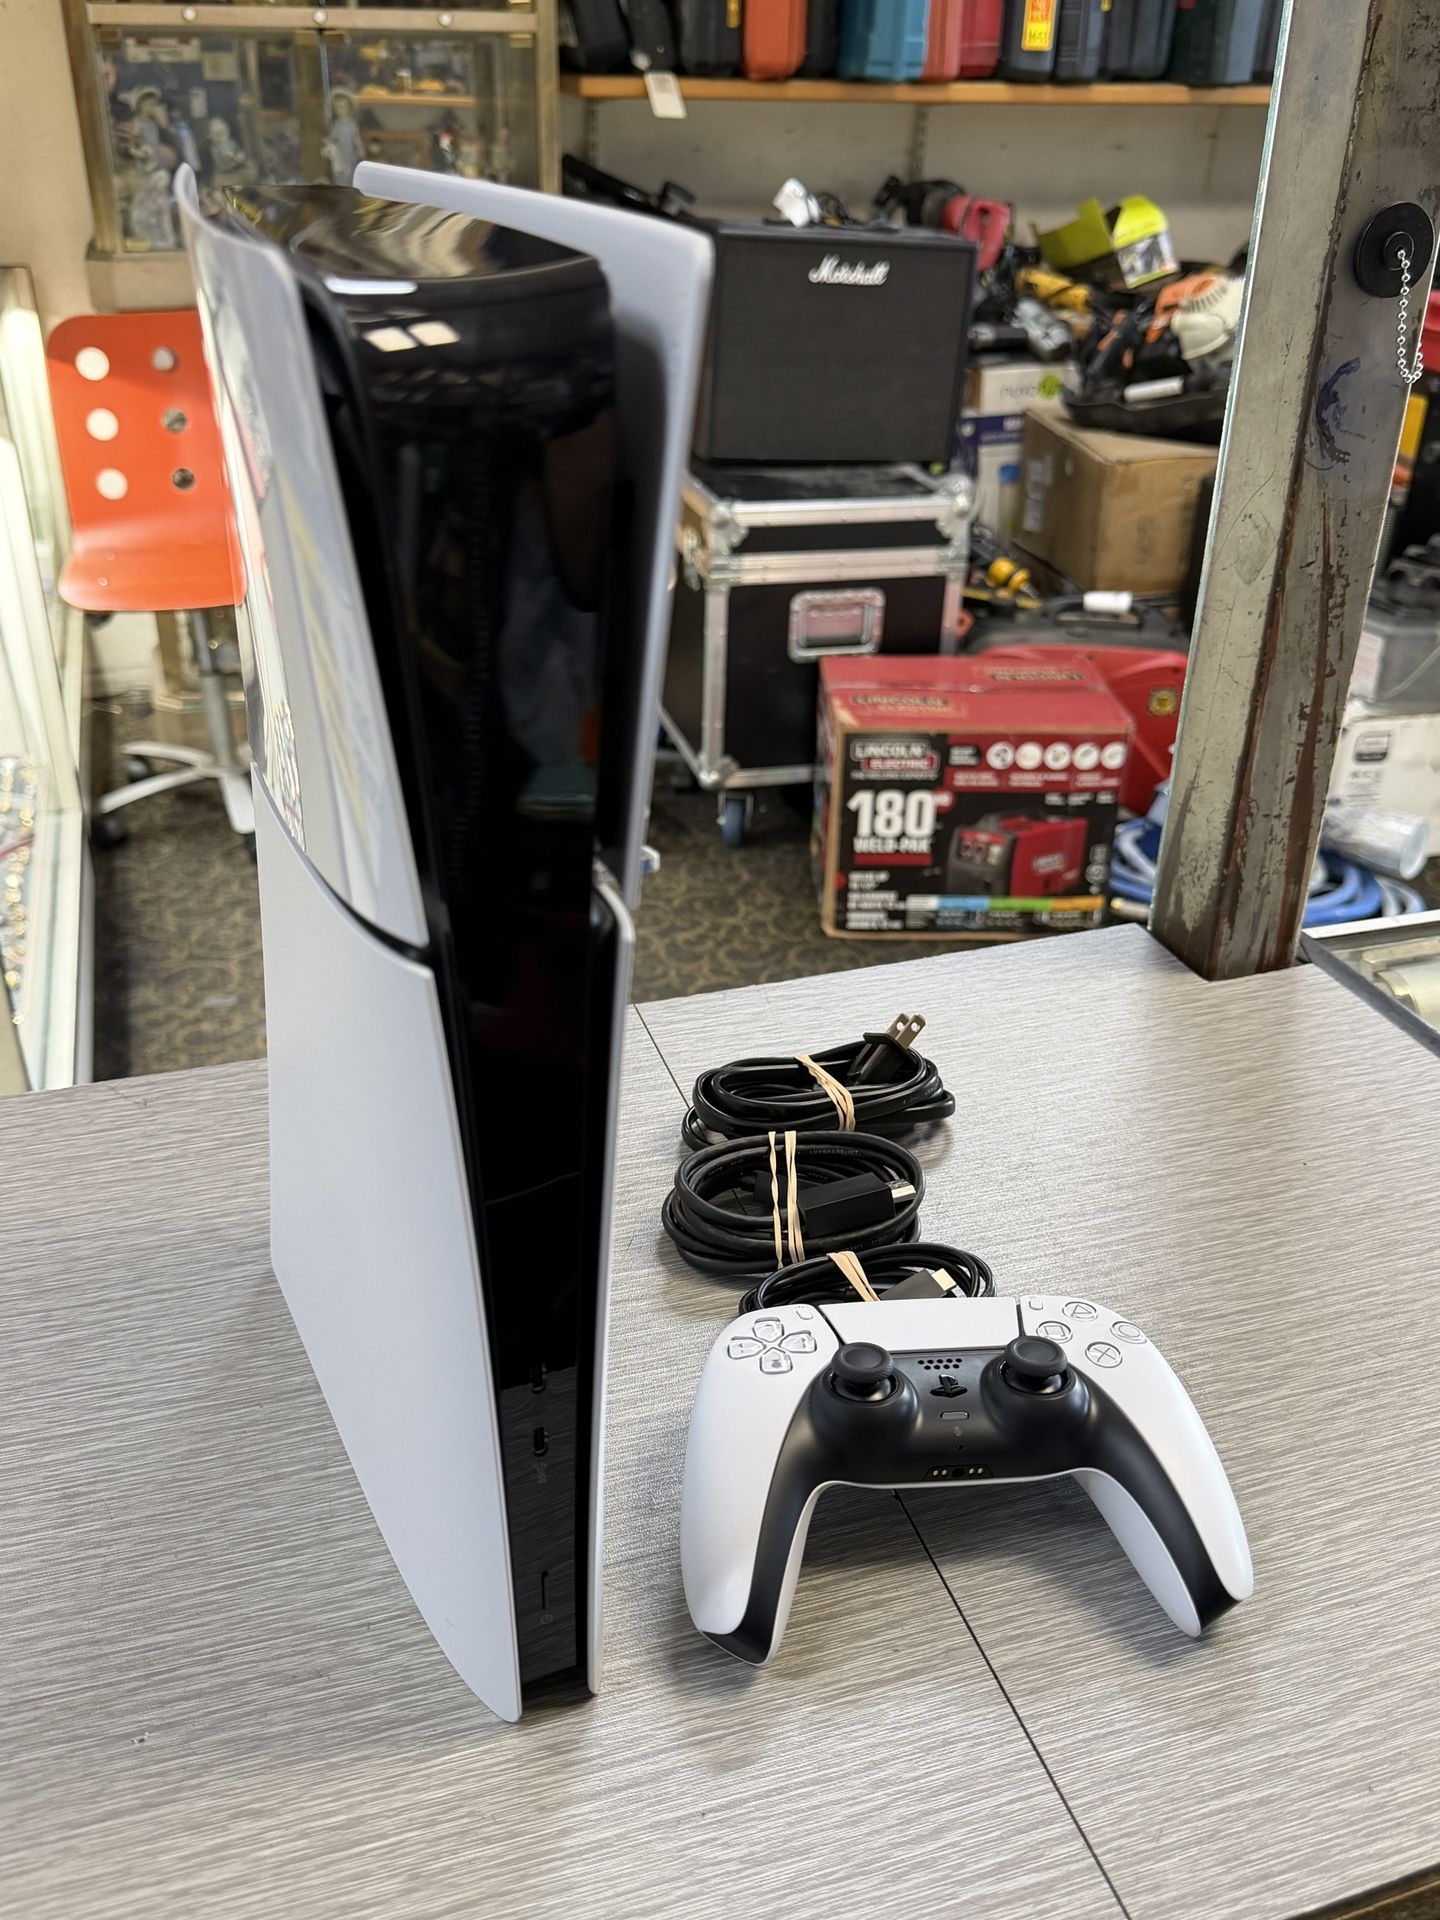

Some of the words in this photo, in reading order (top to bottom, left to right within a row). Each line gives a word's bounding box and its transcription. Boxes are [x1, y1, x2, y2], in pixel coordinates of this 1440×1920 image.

[808, 253, 890, 285] Marshall
[854, 744, 925, 758] LINCOLN
[847, 789, 937, 838] 180
